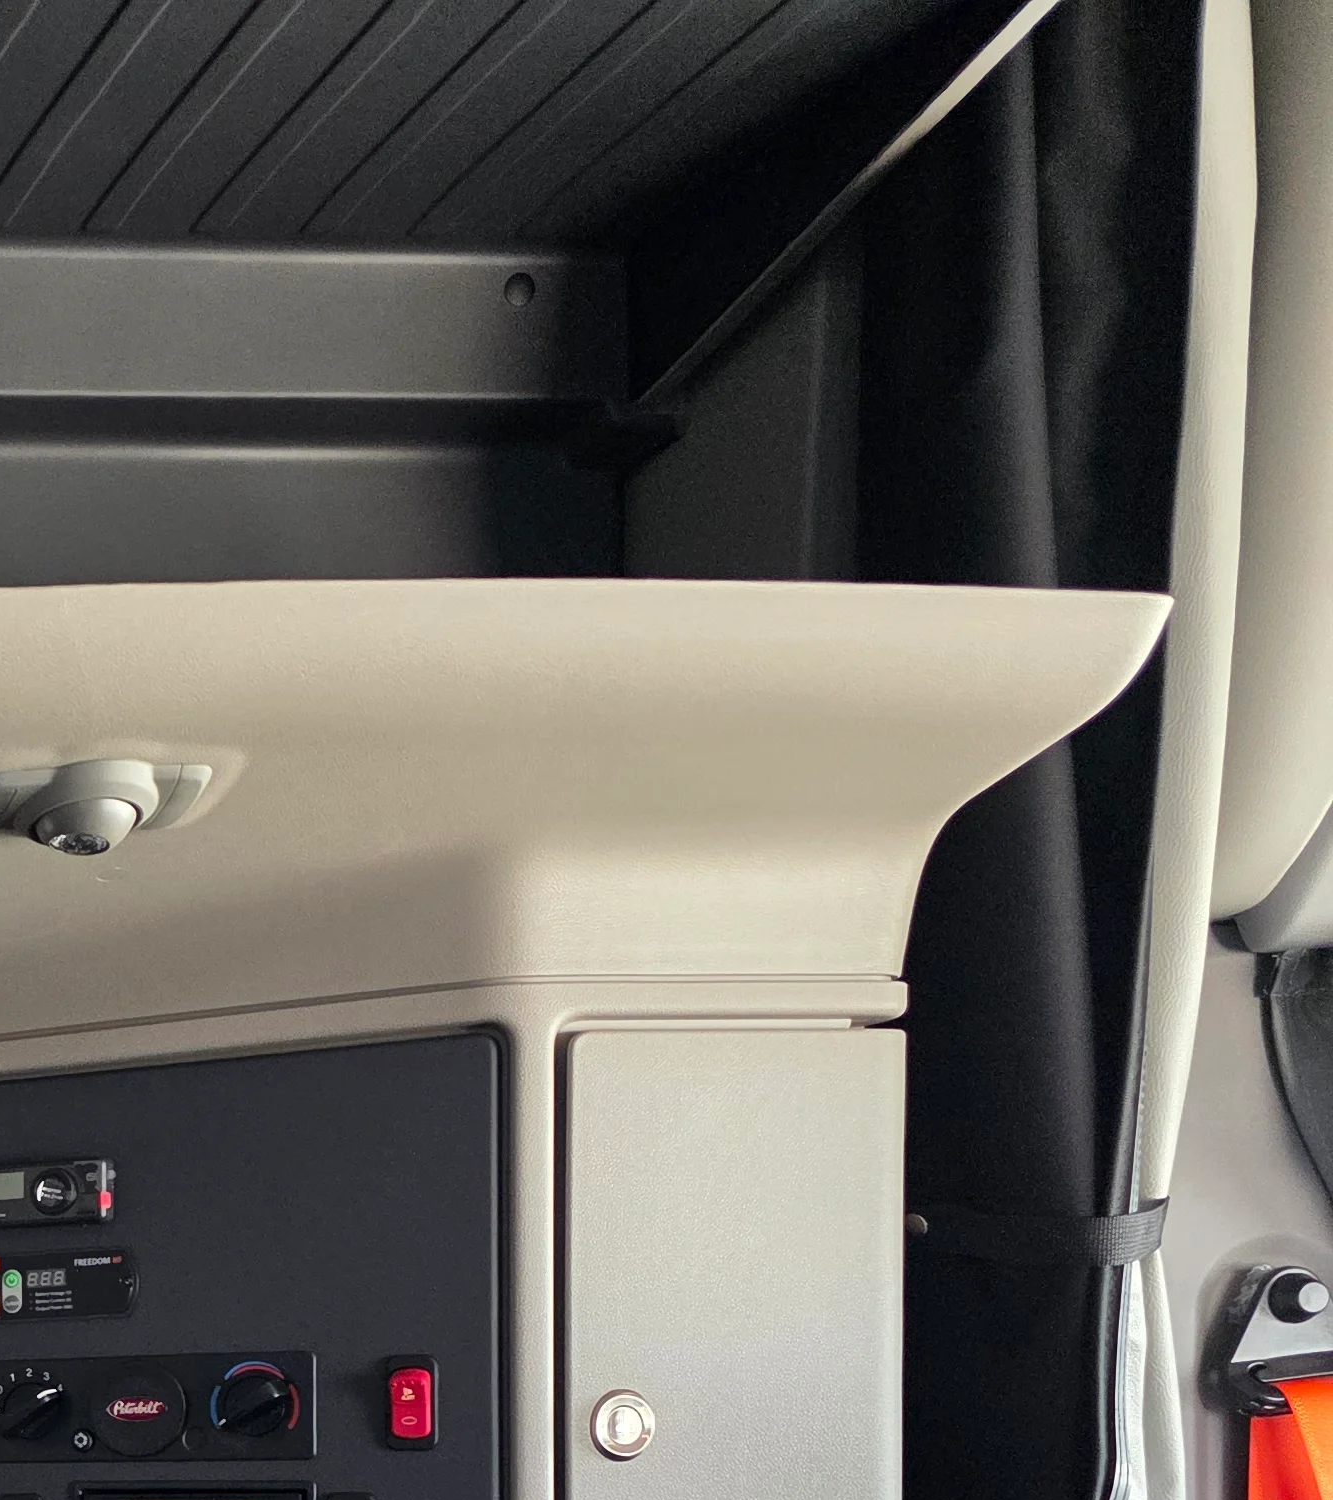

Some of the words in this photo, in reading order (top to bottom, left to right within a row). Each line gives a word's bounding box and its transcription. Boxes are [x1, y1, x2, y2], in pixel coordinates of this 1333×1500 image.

[73, 1256, 111, 1267] FREEDOM
[9, 1373, 16, 1382] 1
[25, 1368, 33, 1378] 2
[42, 1372, 50, 1381] 3
[57, 1383, 64, 1392] 4
[113, 1400, 164, 1417] Peterbilt
